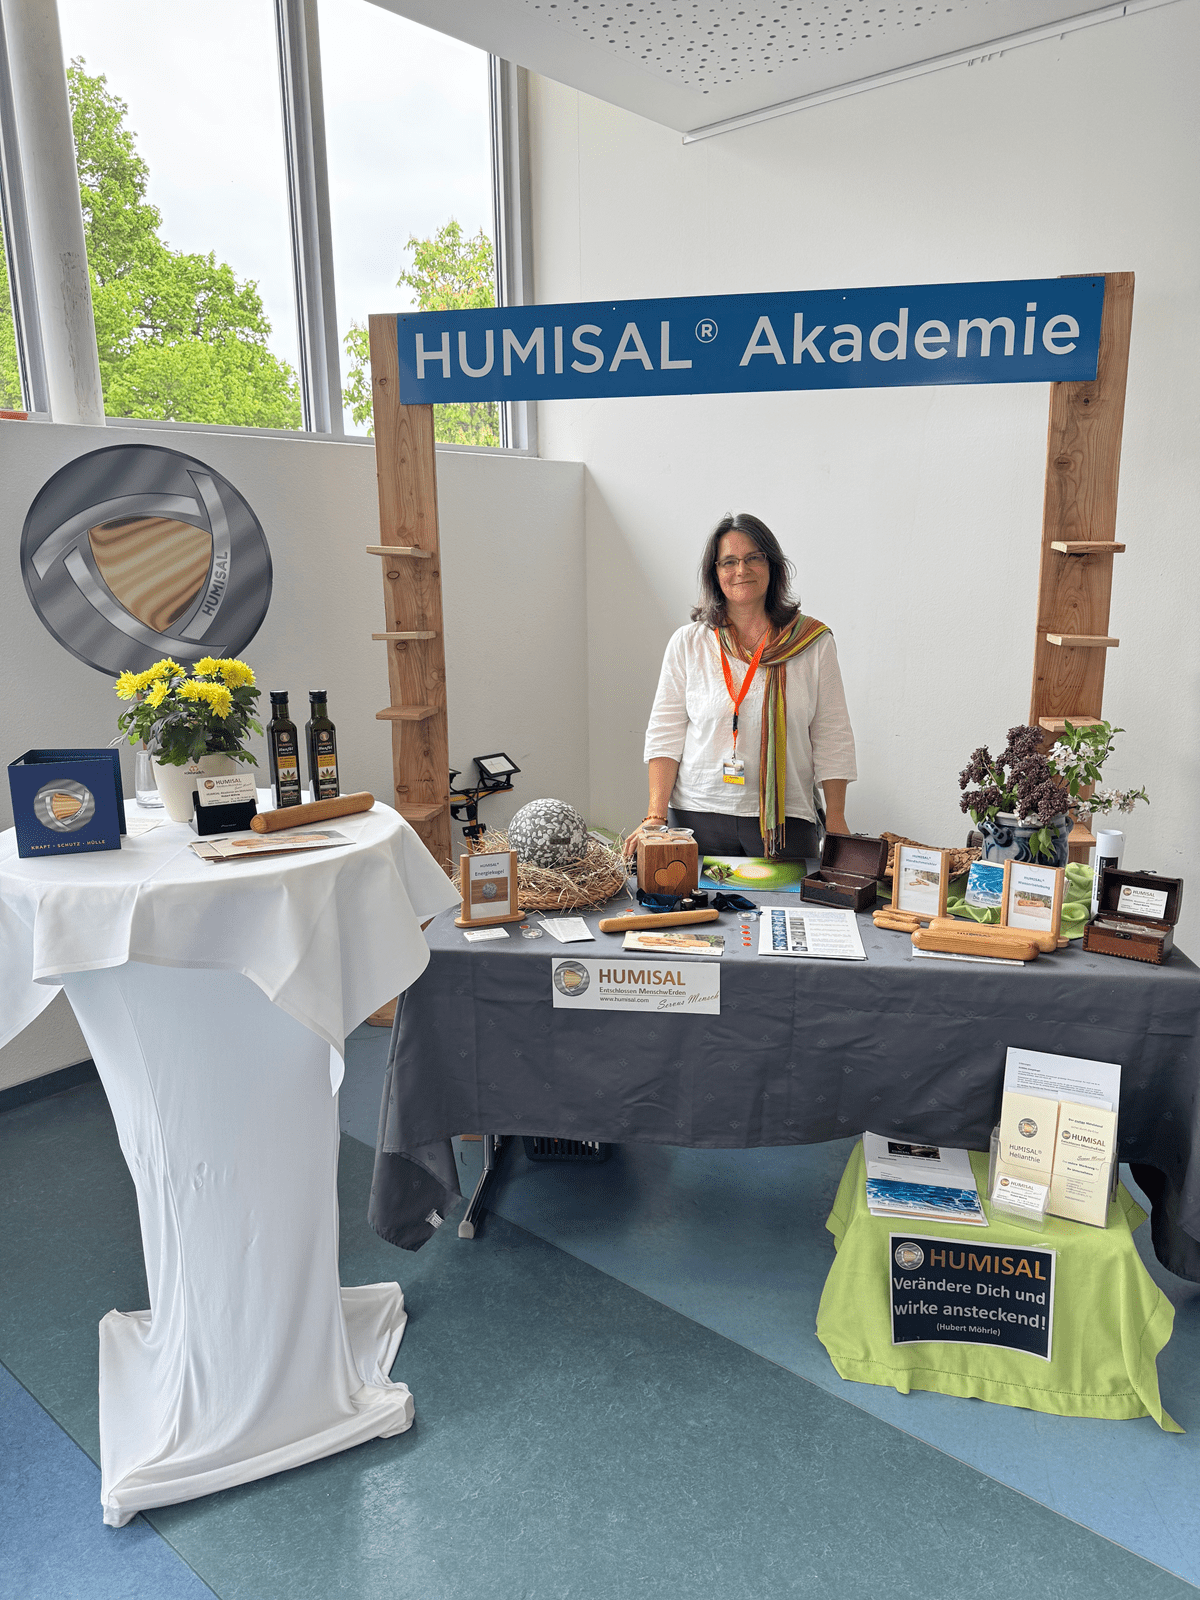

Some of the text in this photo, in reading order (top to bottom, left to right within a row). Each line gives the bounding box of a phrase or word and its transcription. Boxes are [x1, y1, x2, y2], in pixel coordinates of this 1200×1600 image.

[739, 303, 1081, 367] Akademie
[201, 551, 228, 617] HUMISAL
[474, 869, 505, 877] Energiekugel
[599, 968, 686, 986] HUMISAL
[599, 986, 637, 994] Entschlossen
[1071, 1133, 1106, 1147] HUMISAL
[1009, 1151, 1041, 1164] Helianthie
[930, 1249, 1046, 1281] HUMISAL
[893, 1277, 1046, 1306] Verändere Dich und
[894, 1300, 1047, 1331] wirke ansteckend!
[936, 1322, 1001, 1337] (Hubert Möhrle)
